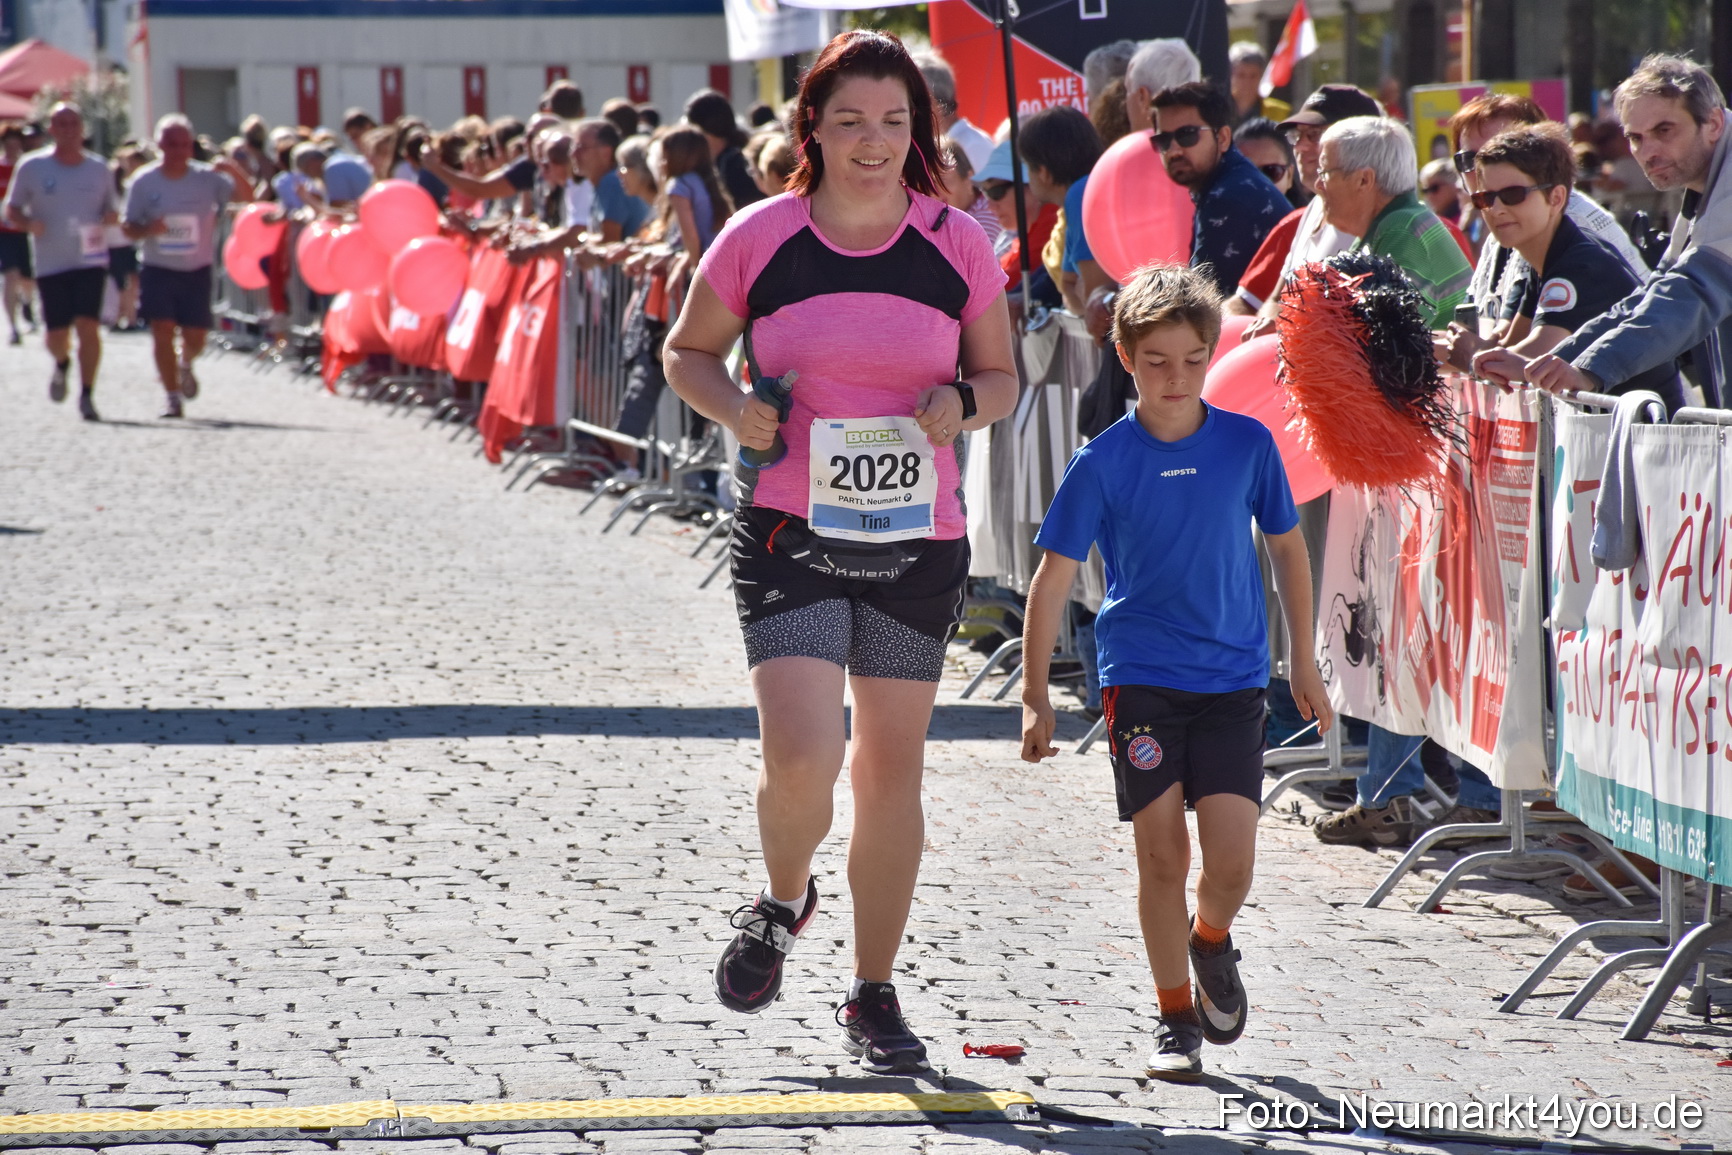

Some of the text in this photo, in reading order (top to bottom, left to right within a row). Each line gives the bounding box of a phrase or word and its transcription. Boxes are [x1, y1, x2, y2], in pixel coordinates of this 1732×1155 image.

[1038, 77, 1078, 98] THE
[845, 429, 903, 444] BOCK
[829, 452, 921, 492] 2028
[838, 495, 901, 505] PARTL Neumarkt
[859, 514, 890, 529] Tina
[836, 567, 899, 579] Kalenji
[1133, 737, 1158, 749] BAYERN
